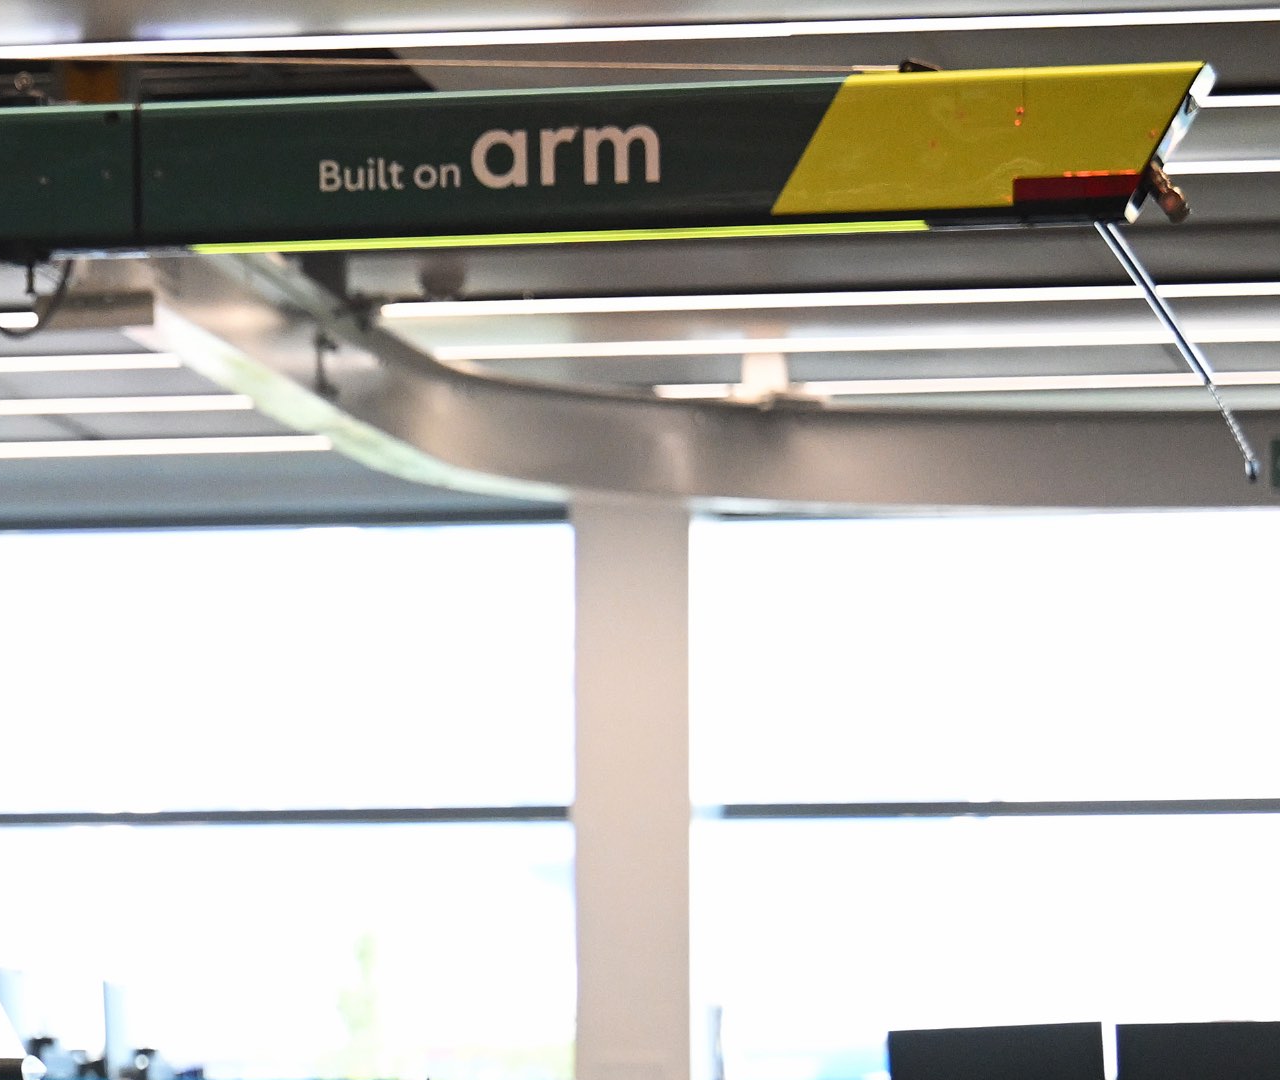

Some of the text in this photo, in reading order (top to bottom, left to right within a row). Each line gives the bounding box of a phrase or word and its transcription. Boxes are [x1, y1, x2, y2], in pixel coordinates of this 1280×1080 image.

[318, 157, 461, 192] Built on
[471, 124, 661, 189] arm
